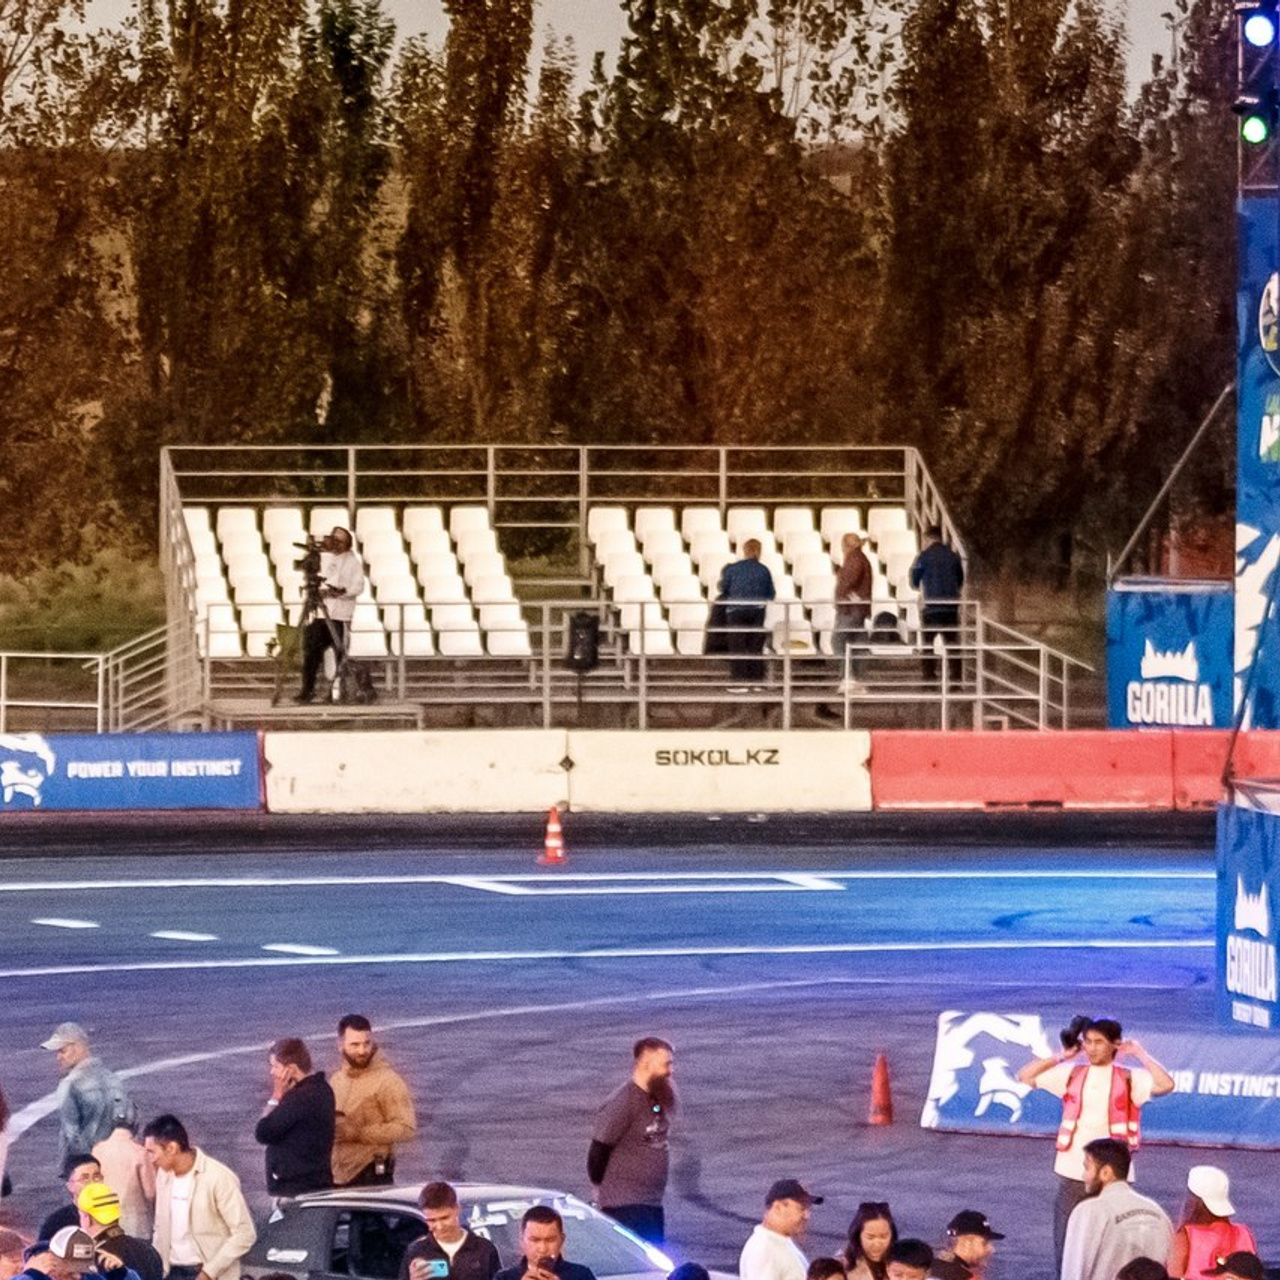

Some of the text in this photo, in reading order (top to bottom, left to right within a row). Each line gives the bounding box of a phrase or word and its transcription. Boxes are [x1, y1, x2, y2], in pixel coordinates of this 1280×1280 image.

[1127, 681, 1213, 725] GORILLA
[67, 759, 242, 778] POWER YOUR INSTINCT
[1226, 935, 1277, 1002] GORILLA
[1198, 1071, 1280, 1098] INSTINC
